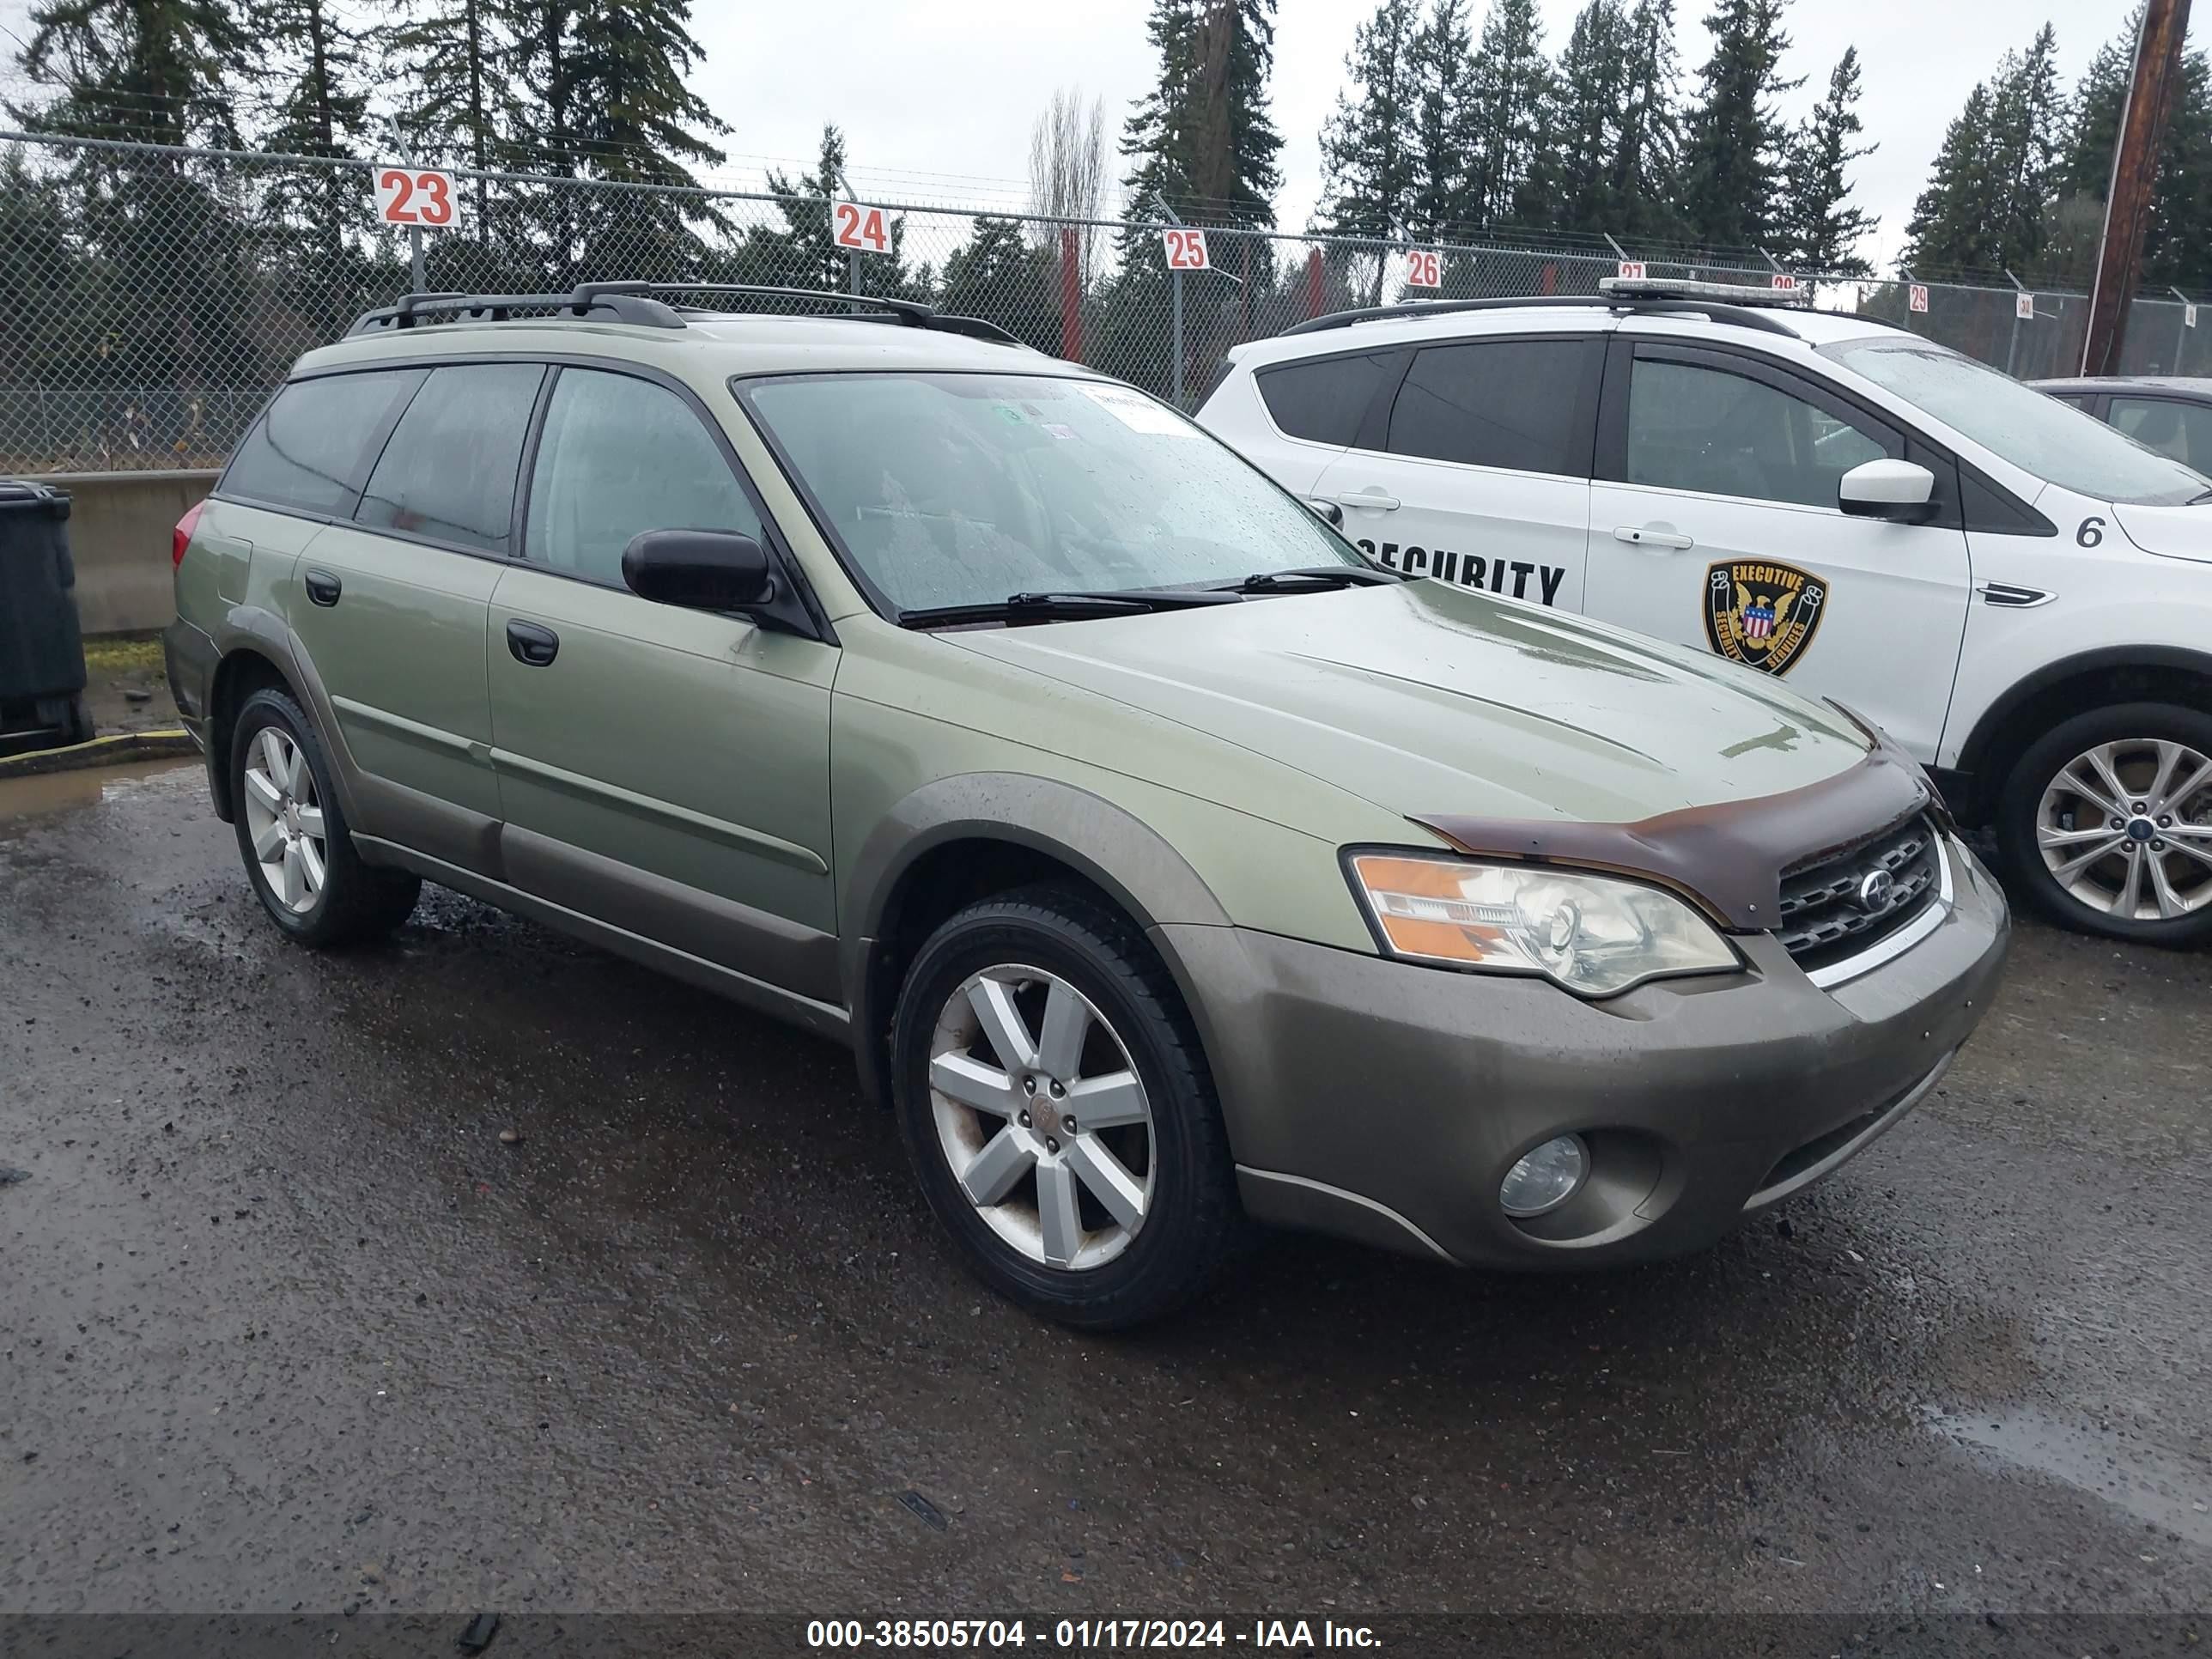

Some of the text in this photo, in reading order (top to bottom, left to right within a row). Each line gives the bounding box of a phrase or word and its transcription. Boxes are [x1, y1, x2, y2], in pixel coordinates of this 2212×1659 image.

[380, 170, 452, 225] 23
[837, 204, 887, 251] 24
[1167, 231, 1205, 268] 25
[1409, 252, 1439, 286] 26
[1911, 287, 1927, 311] 29
[2075, 516, 2106, 548] 6
[1732, 565, 1805, 592] EXECUTIVE
[1766, 622, 1805, 668] SERVICES
